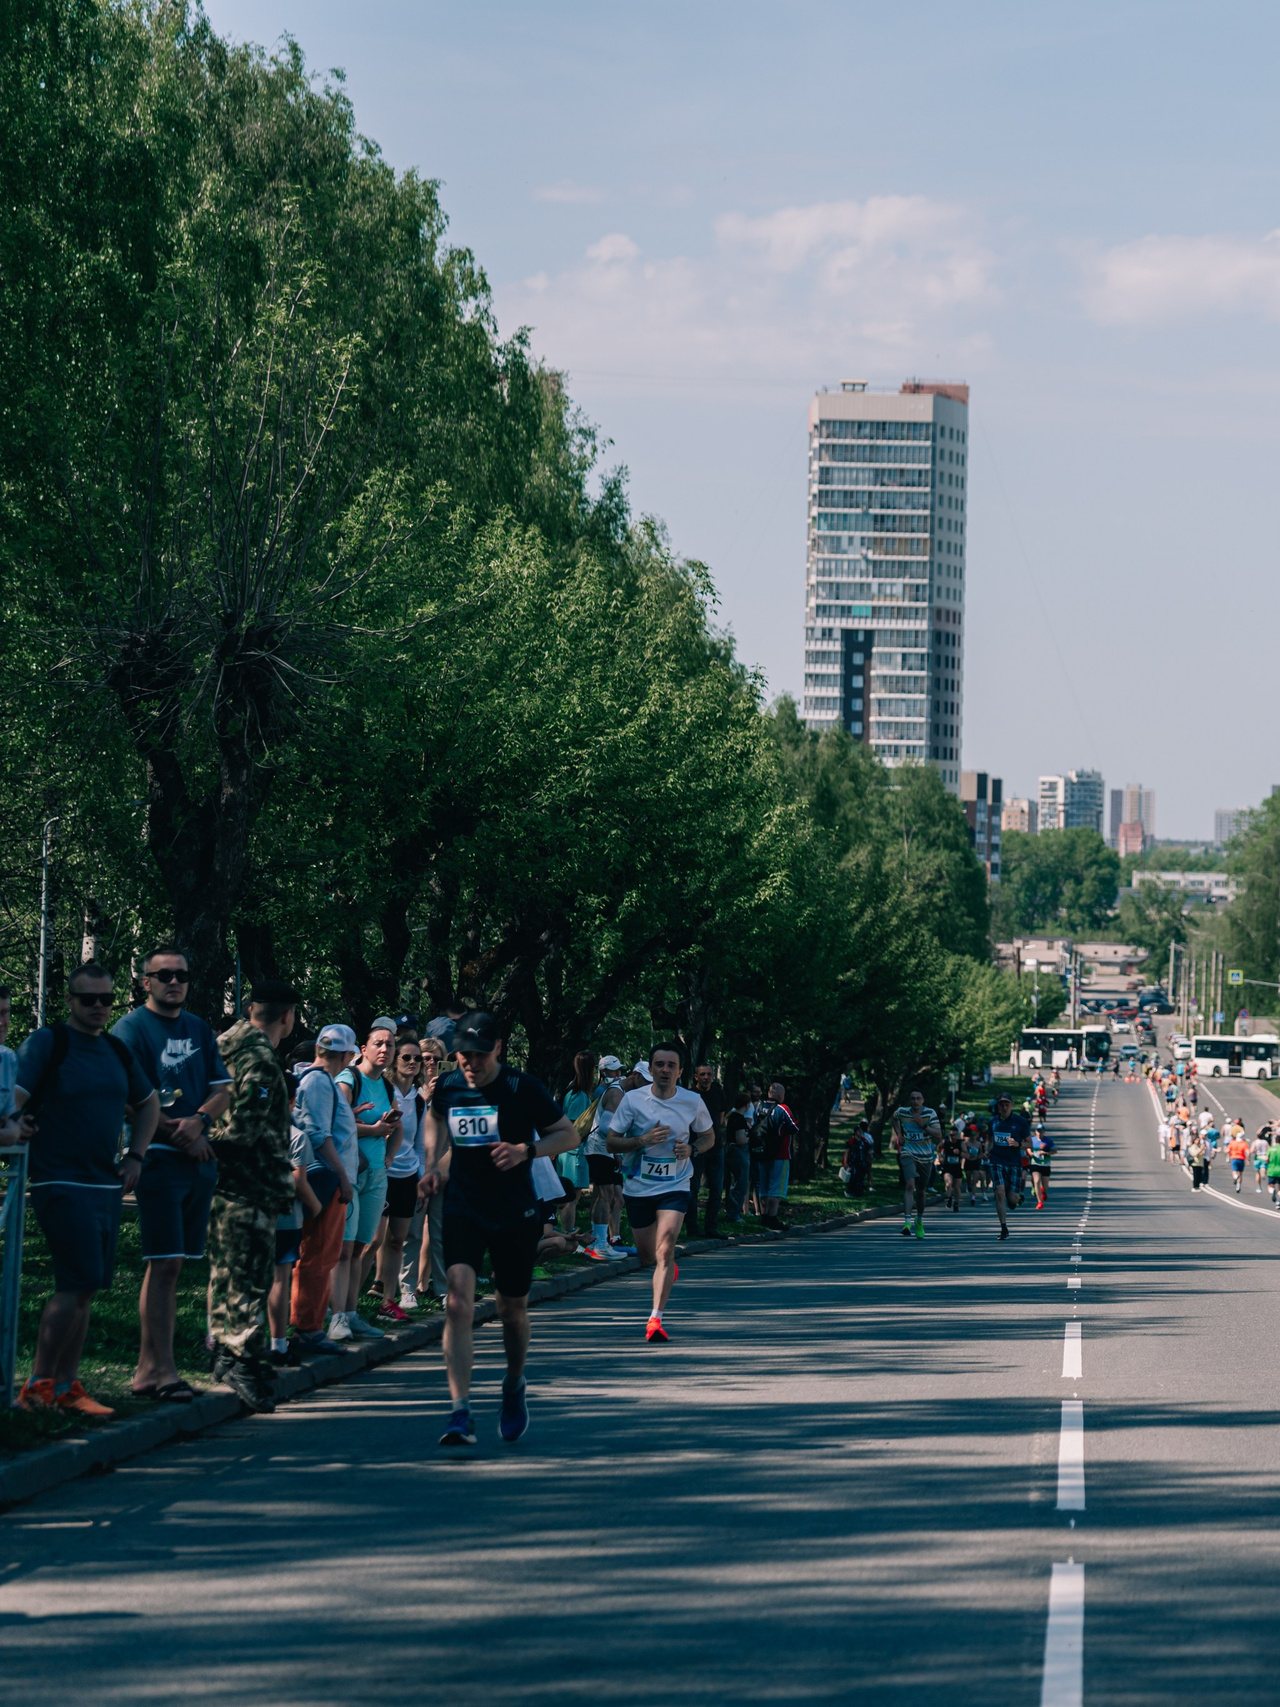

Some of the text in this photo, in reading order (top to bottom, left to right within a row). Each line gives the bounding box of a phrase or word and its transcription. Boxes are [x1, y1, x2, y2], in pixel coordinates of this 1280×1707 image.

[167, 1038, 193, 1054] NIKE
[458, 1117, 489, 1135] 810
[647, 1163, 670, 1176] 741
